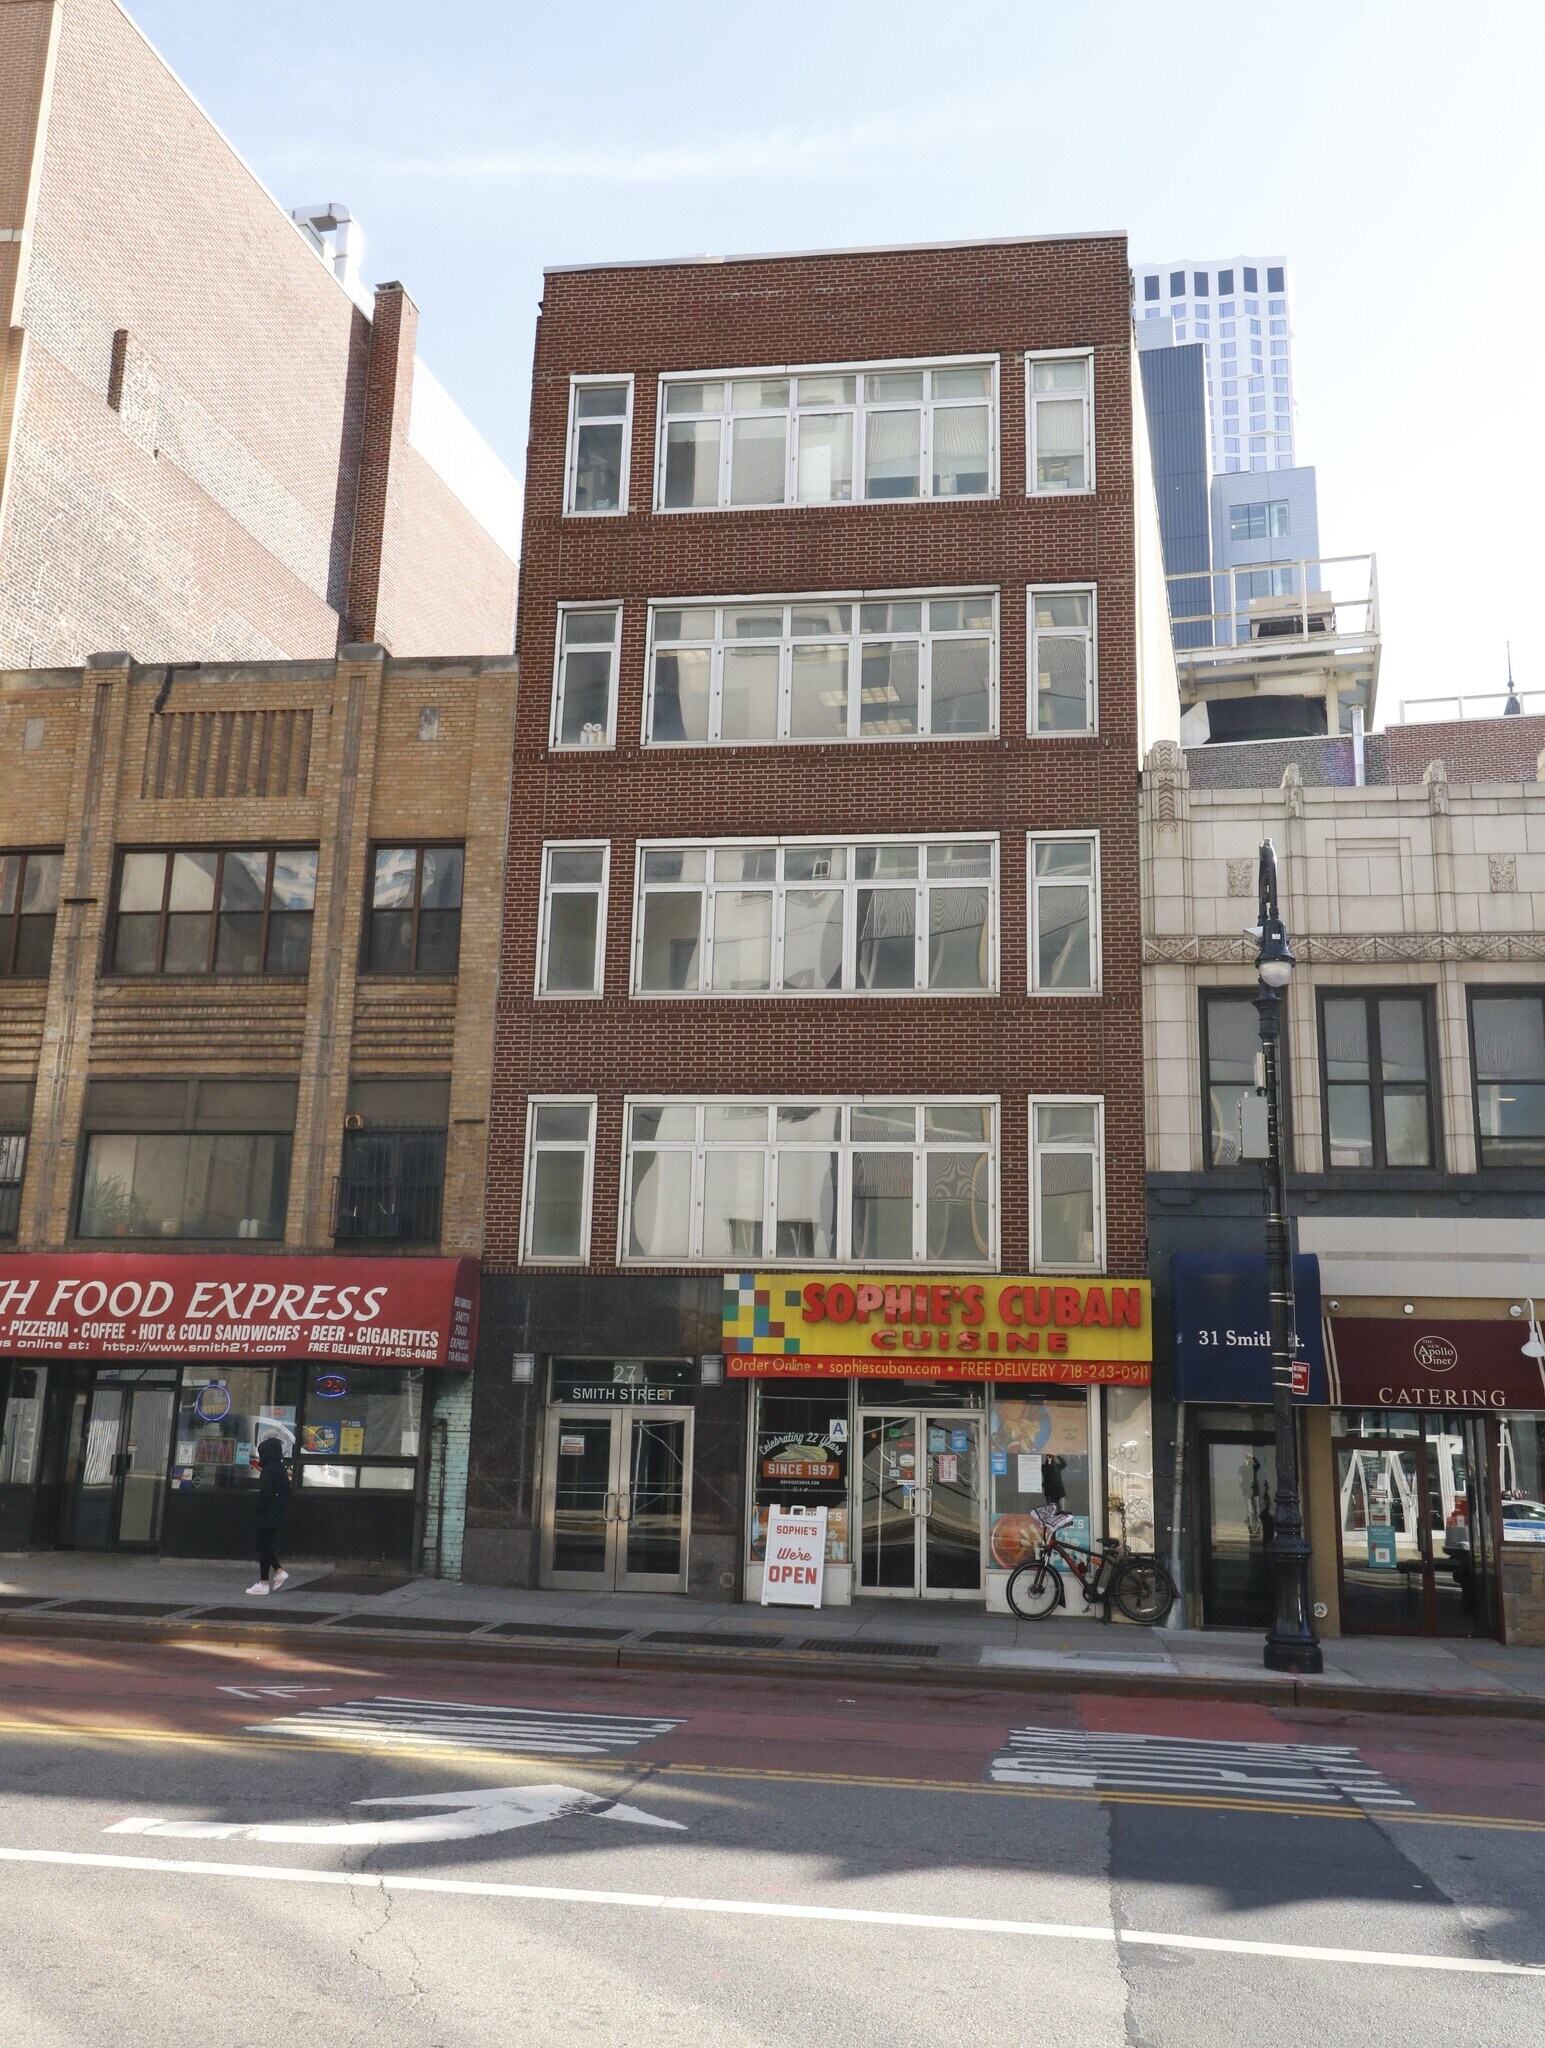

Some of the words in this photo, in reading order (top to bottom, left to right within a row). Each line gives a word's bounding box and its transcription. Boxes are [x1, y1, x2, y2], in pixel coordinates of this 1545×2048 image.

[46, 1280, 174, 1317] FOOD
[185, 1282, 389, 1322] EXPRESS
[802, 1283, 985, 1326] SOPHIE'S
[998, 1286, 1141, 1327] CUBAN
[9, 1320, 69, 1338] PIZZERIA
[81, 1322, 126, 1339] COFFEE
[139, 1323, 164, 1340] HOT
[166, 1324, 176, 1340] &
[179, 1324, 212, 1340] COLD
[215, 1324, 300, 1341] SANDWICHES
[311, 1325, 346, 1342] BEER
[357, 1326, 439, 1348] CIGARETTES
[871, 1330, 1069, 1353] CUISINE
[1199, 1330, 1219, 1345] 31
[17, 1339, 63, 1350] online
[68, 1342, 90, 1350] at:
[102, 1342, 286, 1353] http://www.smith21.com
[308, 1342, 330, 1353] FREE
[331, 1344, 373, 1356] DELIVERY
[375, 1346, 437, 1360] 718-855-0405
[1418, 1345, 1454, 1357] Apollo
[1421, 1354, 1452, 1365] Diner
[612, 1365, 637, 1383] 27
[731, 1358, 769, 1371] Order
[773, 1358, 811, 1371] Online
[830, 1359, 941, 1376] sophiescuban.com
[961, 1361, 992, 1376] FREE
[995, 1362, 1056, 1378] DELIVERY
[1061, 1364, 1148, 1380] 718-243-0911
[572, 1387, 615, 1400] SMITH
[619, 1388, 675, 1401] STREET
[1378, 1387, 1507, 1407] CATERING
[832, 1422, 844, 1435] A
[195, 1440, 234, 1463] ATM
[759, 1431, 804, 1455] Celebrating
[806, 1432, 819, 1443] 22
[818, 1435, 843, 1456] Years
[768, 1463, 803, 1475] SINCE
[808, 1464, 834, 1476] 1997
[776, 1525, 818, 1536] SOPHIE'S
[776, 1547, 812, 1561] We're
[768, 1565, 818, 1585] OPEN
